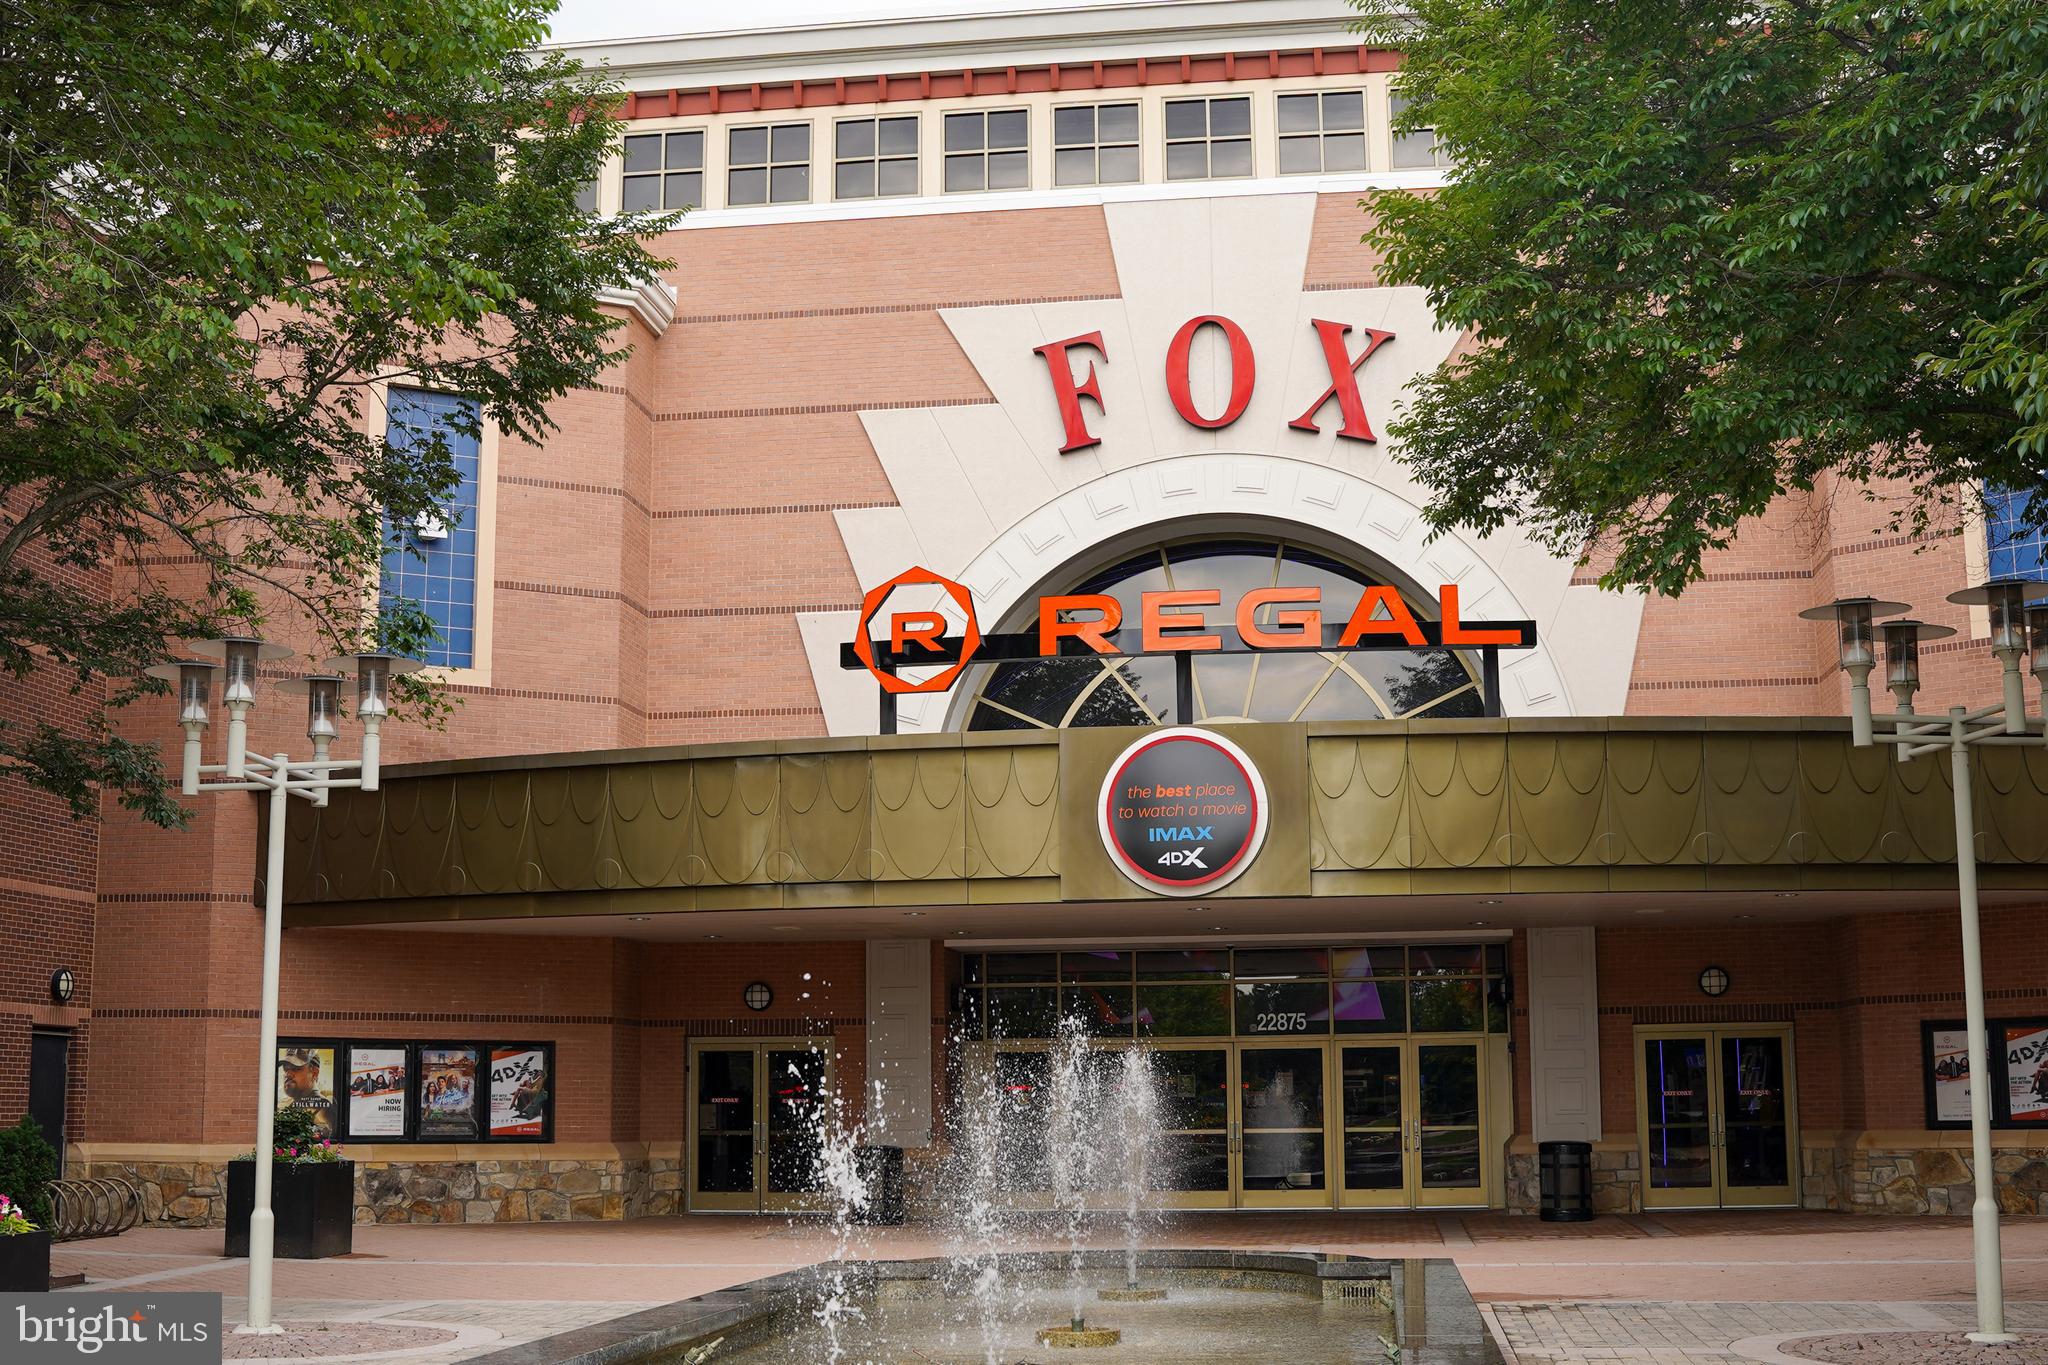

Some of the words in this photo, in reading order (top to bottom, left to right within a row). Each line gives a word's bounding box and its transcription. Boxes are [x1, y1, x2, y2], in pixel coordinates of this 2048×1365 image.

[1033, 314, 1396, 455] FOX
[1038, 583, 1522, 657] REGAL
[891, 611, 949, 654] R
[1127, 785, 1152, 799] the
[1156, 784, 1192, 798] best
[1195, 783, 1236, 799] place
[1118, 806, 1134, 819] to
[1138, 803, 1185, 818] watch
[1189, 805, 1199, 816] a
[1202, 801, 1248, 816] movie
[1148, 826, 1214, 843] IMAX
[1157, 846, 1209, 869] 4DX
[1257, 1012, 1307, 1031] 22875
[491, 1055, 537, 1083] 4DX
